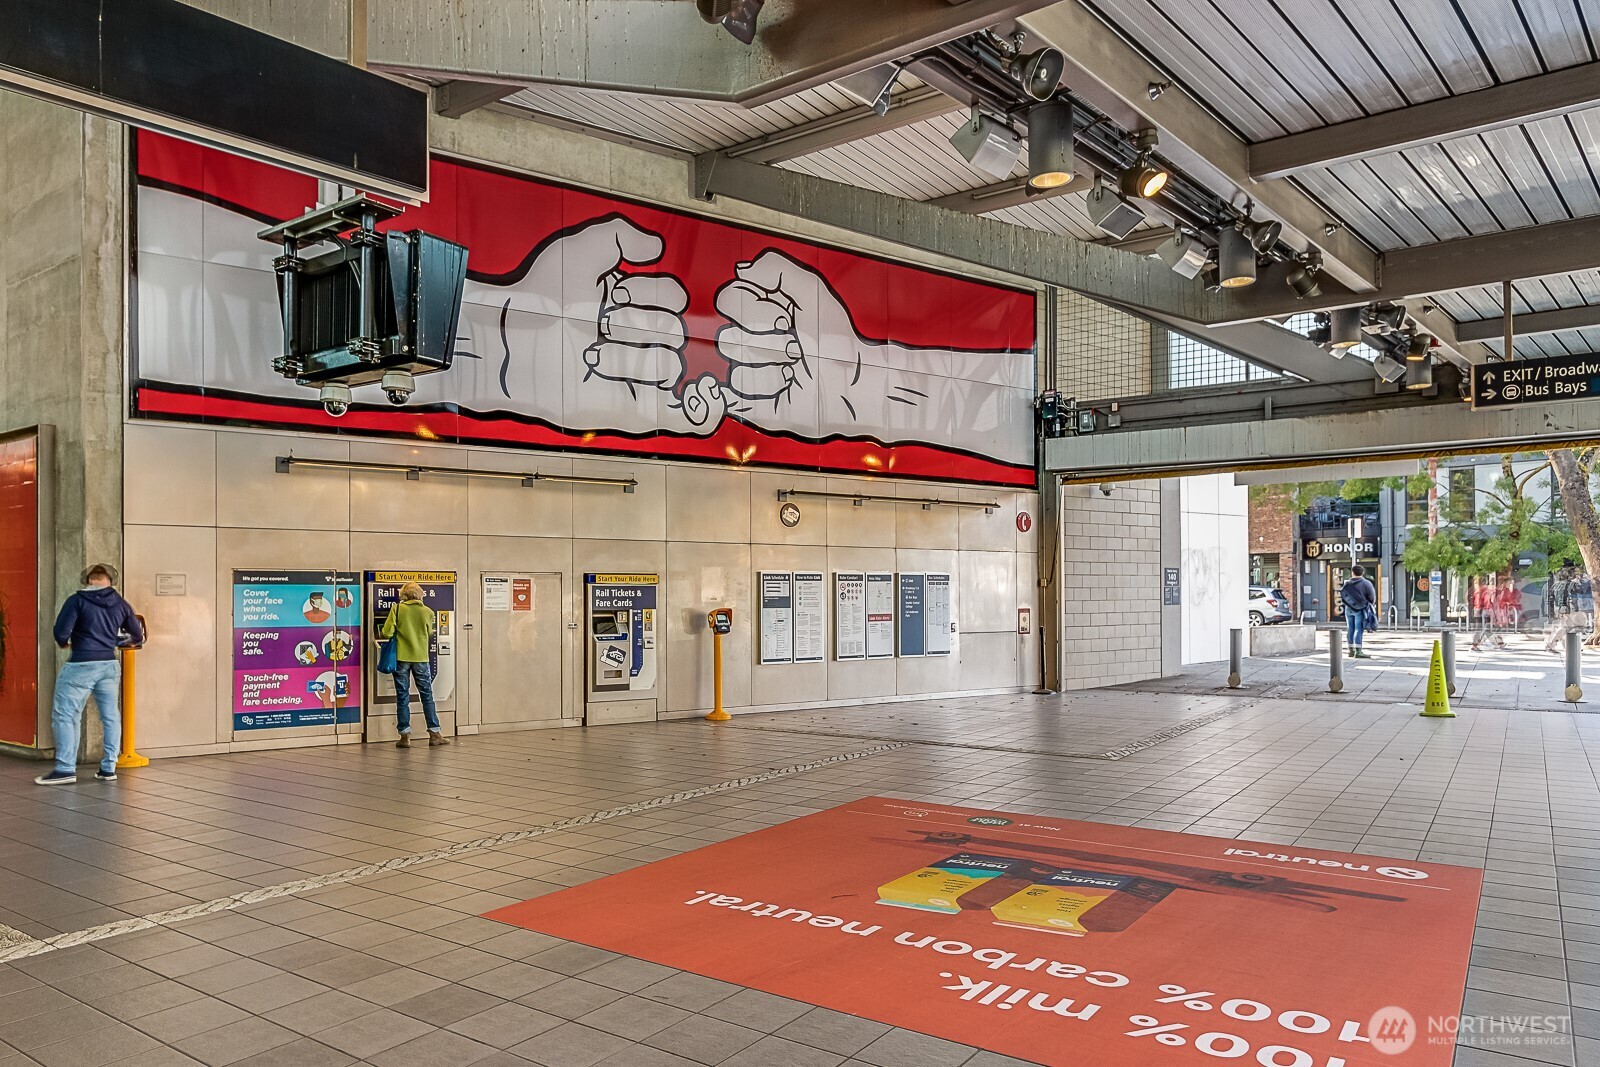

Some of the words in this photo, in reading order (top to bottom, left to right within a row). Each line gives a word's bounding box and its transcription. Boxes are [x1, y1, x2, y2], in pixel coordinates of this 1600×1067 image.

[1525, 384, 1549, 396] Bus
[1555, 381, 1587, 395] Bays
[1324, 542, 1374, 553] HONOR
[243, 589, 269, 597] Cover
[378, 588, 395, 597] Rail
[429, 589, 436, 597] &
[595, 589, 610, 597] Rail
[611, 588, 635, 597] Tickets
[636, 589, 642, 597] &
[242, 598, 263, 606] your
[263, 597, 283, 605] face
[378, 600, 396, 609] Fare
[595, 599, 611, 607] Fare
[612, 598, 633, 607] Cards
[243, 605, 267, 613] when
[242, 614, 259, 622] you
[260, 612, 279, 620] ride.
[243, 631, 279, 641] Keeping
[242, 641, 259, 649] you
[242, 647, 263, 655] safe.
[243, 674, 289, 682] Touch-free
[242, 682, 281, 691] payment
[242, 690, 260, 698] and
[242, 698, 261, 706] fare
[262, 696, 302, 706] checking.
[946, 858, 1009, 870] neutral
[1223, 847, 1370, 872] neutral
[1051, 875, 1120, 887] neutral
[684, 890, 883, 937] neutral.
[893, 931, 1130, 988] carbon
[938, 971, 1102, 1021] milk.
[1154, 984, 1371, 1043] 100%
